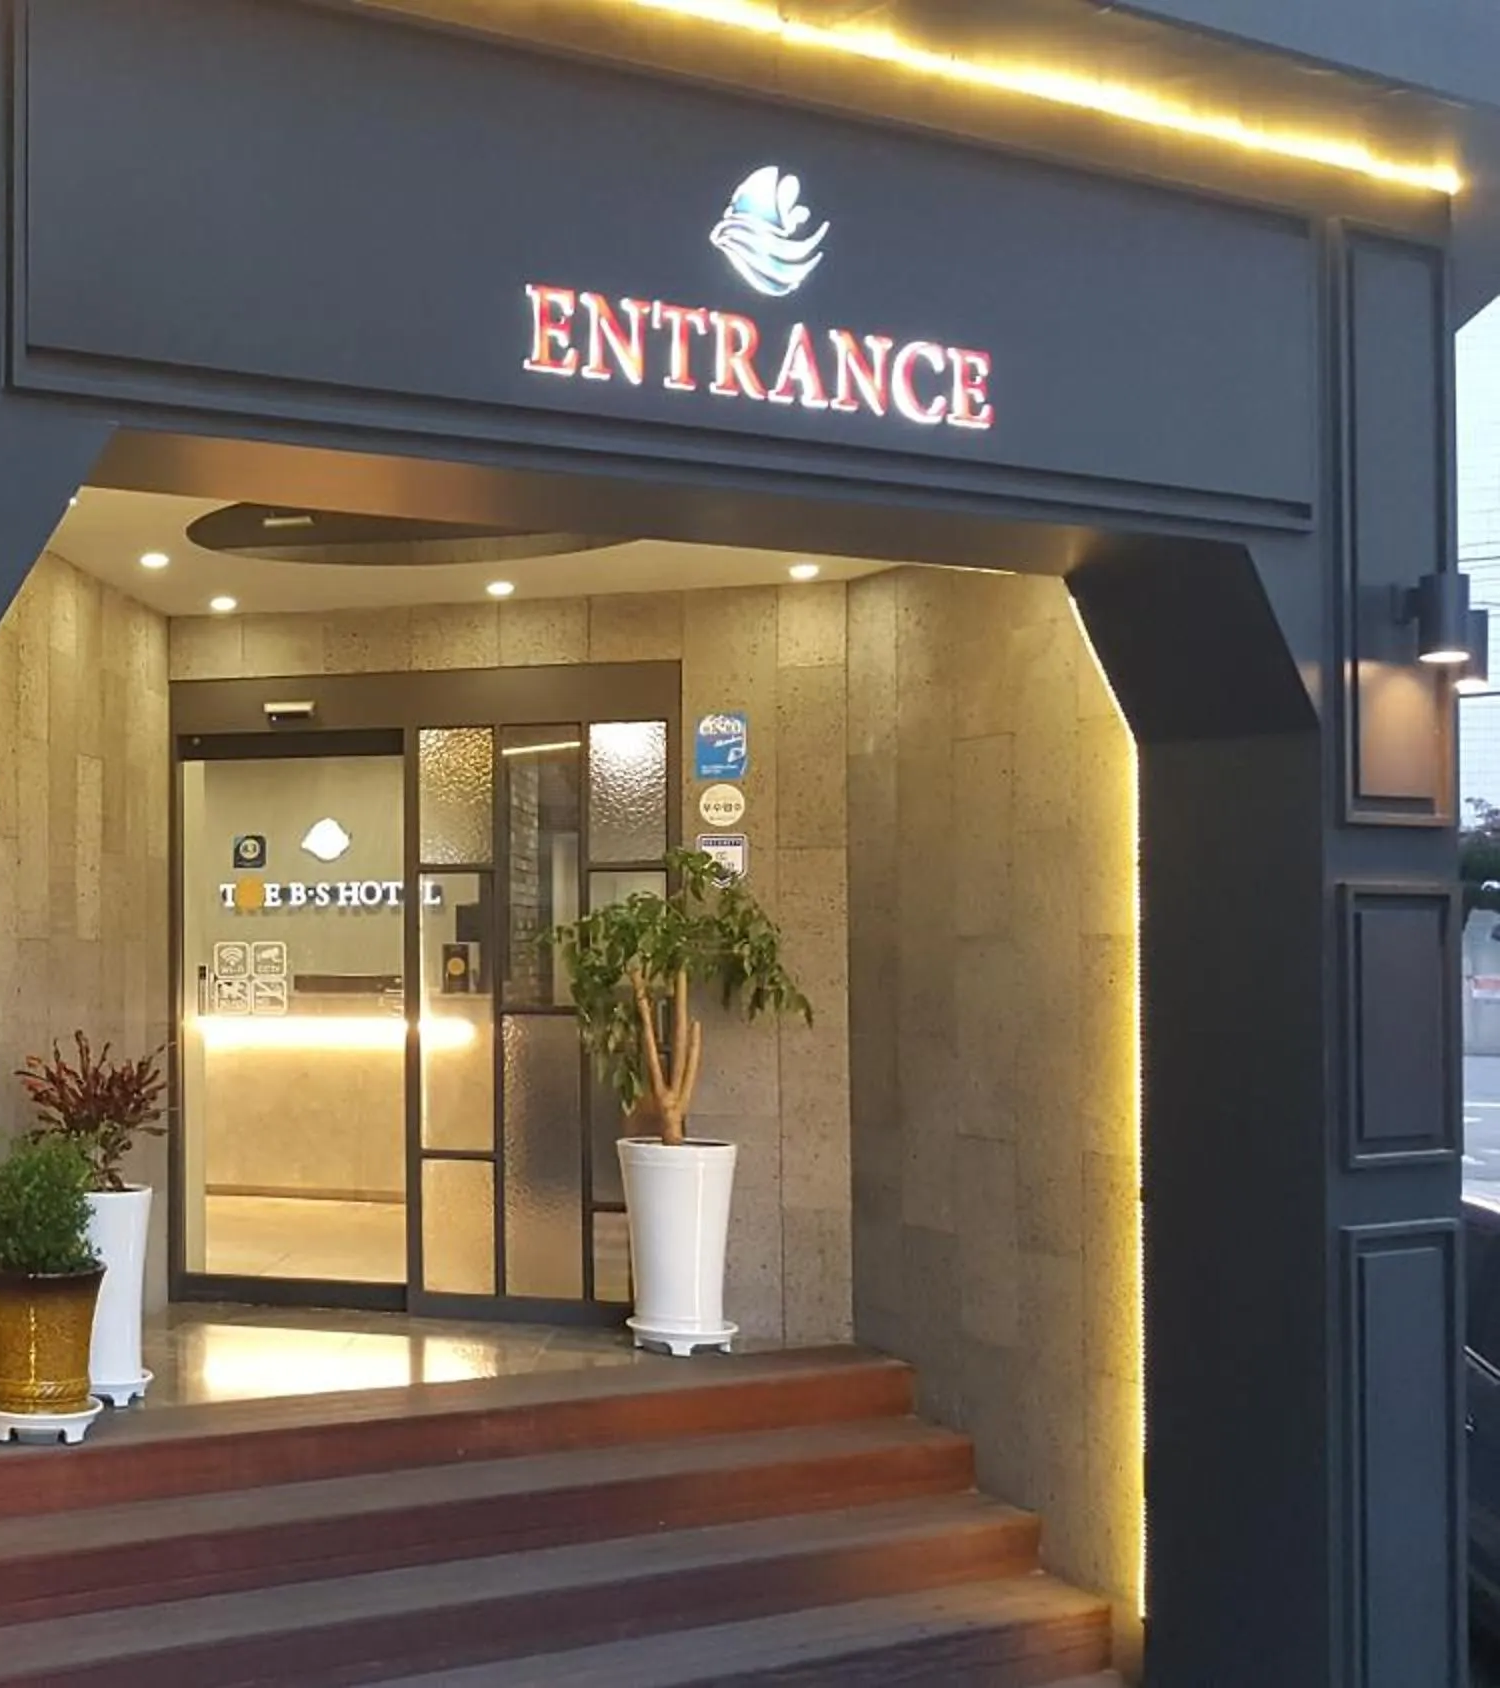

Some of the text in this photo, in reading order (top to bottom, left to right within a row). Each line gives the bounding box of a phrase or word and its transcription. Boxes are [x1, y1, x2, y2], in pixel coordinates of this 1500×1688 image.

[524, 284, 994, 429] ENTRANCE
[219, 883, 282, 908] TE
[335, 880, 442, 907] HOTL
